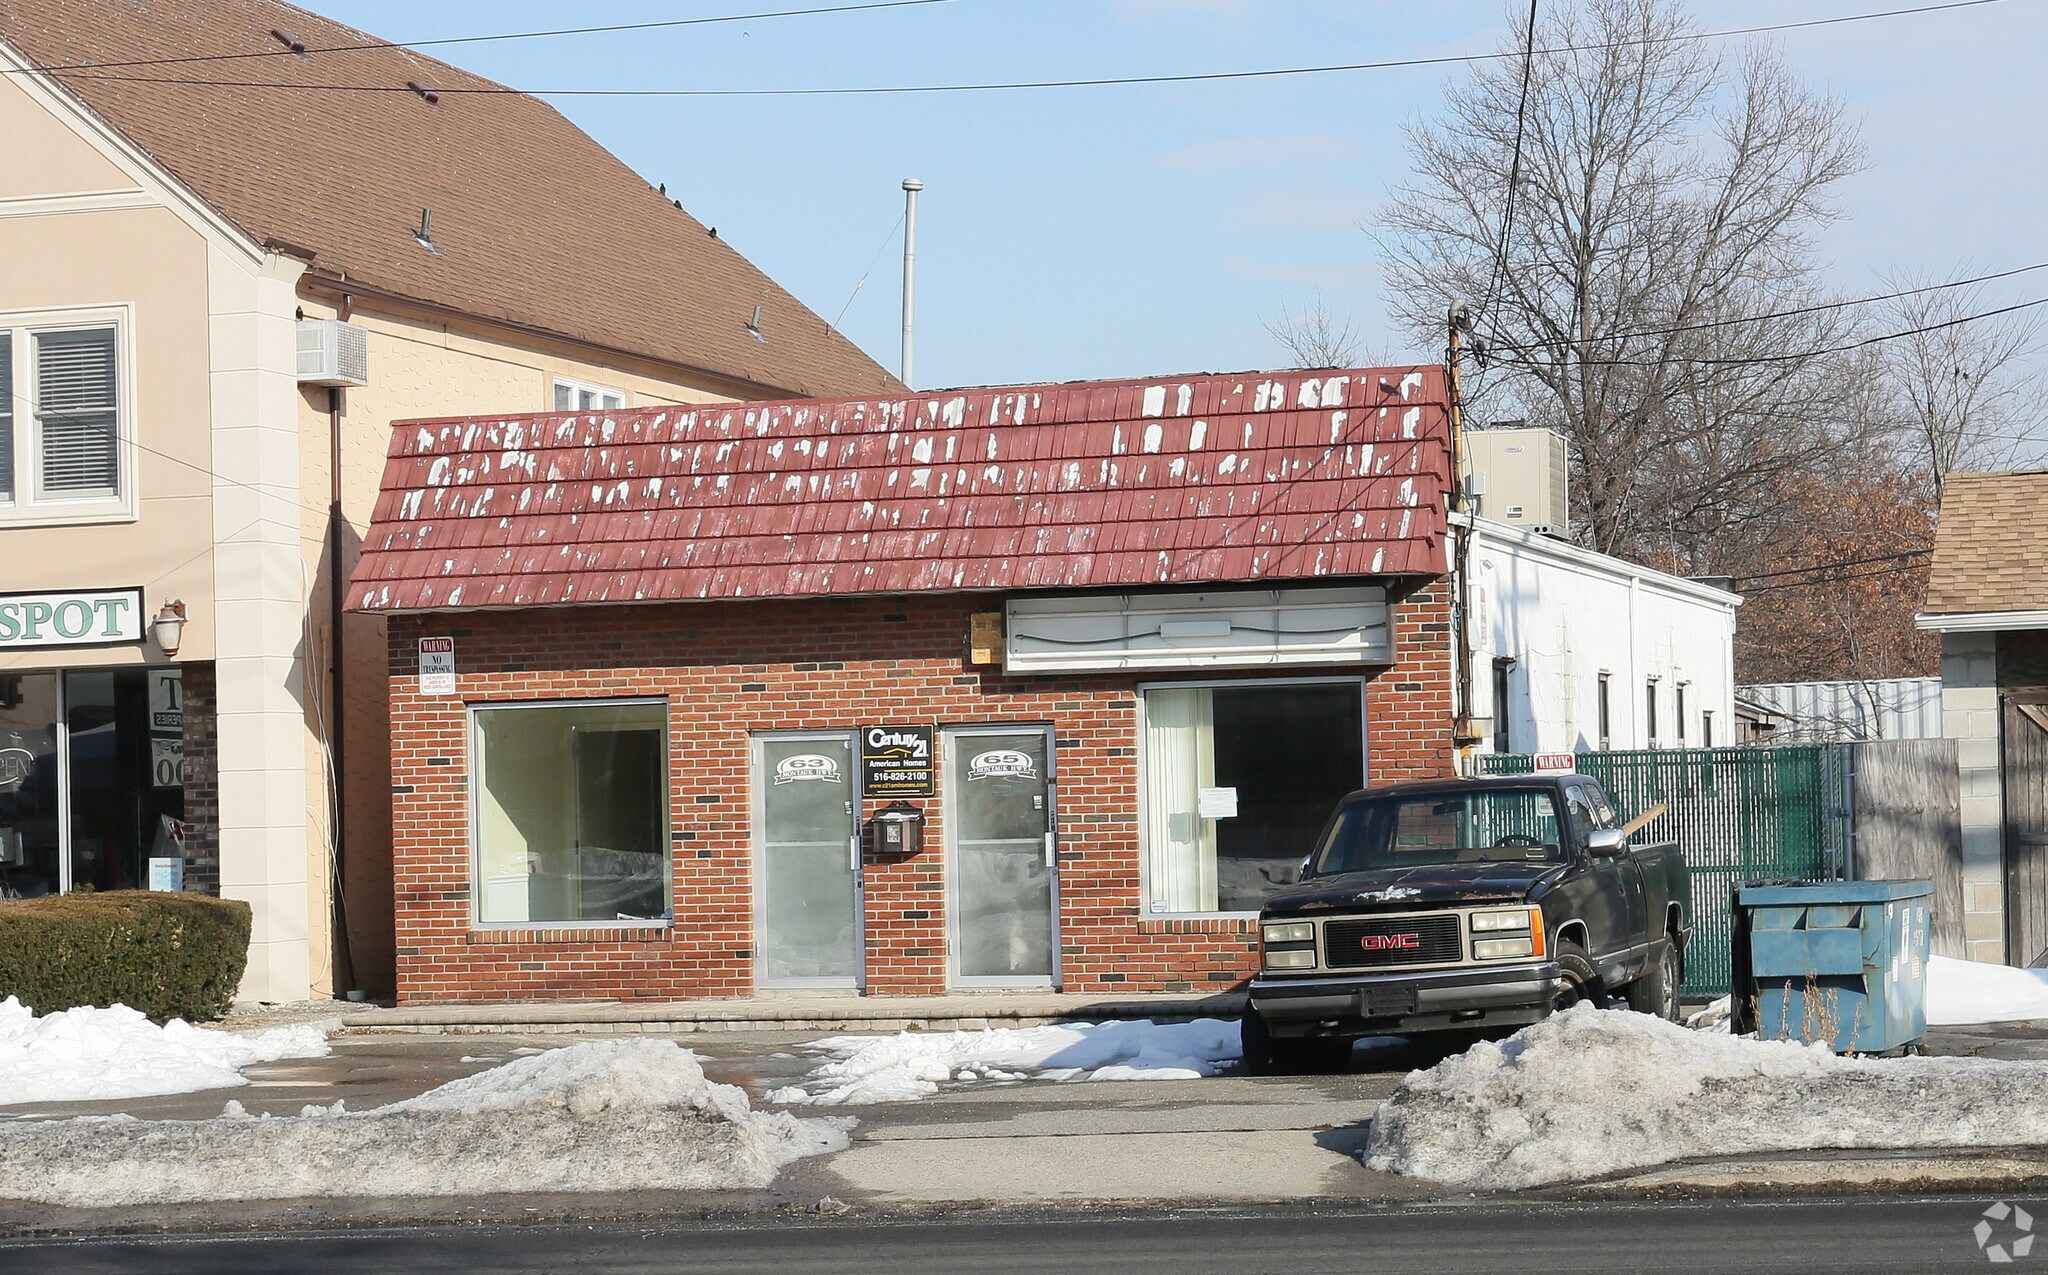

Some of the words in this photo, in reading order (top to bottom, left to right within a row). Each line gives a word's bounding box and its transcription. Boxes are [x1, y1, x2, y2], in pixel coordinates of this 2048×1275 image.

[0, 599, 129, 641] SPOT
[423, 641, 450, 651] WARNING
[432, 655, 442, 664] NO
[868, 728, 918, 748] Century
[789, 759, 824, 768] 63
[903, 759, 927, 767] Homes
[983, 754, 1019, 764] 65
[1538, 755, 1571, 768] WARNING
[873, 772, 927, 781] 516-826-2100
[1361, 933, 1419, 950] GMC
